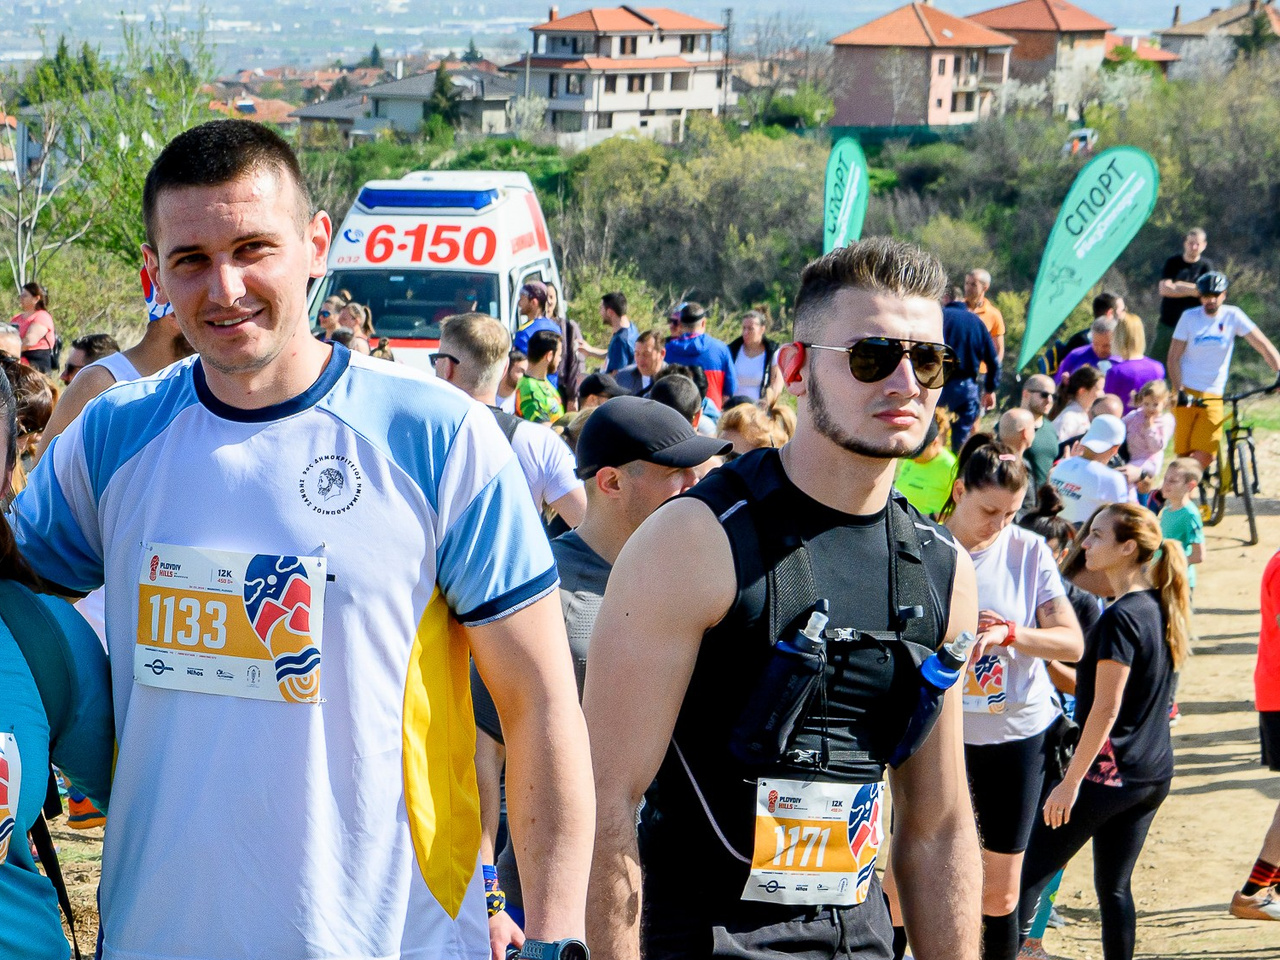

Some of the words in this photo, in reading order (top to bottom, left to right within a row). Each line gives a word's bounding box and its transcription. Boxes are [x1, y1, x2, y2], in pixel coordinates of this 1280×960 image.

[1065, 157, 1124, 236] СПОРТ
[337, 255, 360, 264] 032
[160, 562, 182, 571] PLOVDIV
[158, 569, 174, 578] HILLS
[217, 568, 233, 578] 12K
[149, 593, 228, 650] 1133
[772, 825, 831, 867] 1171
